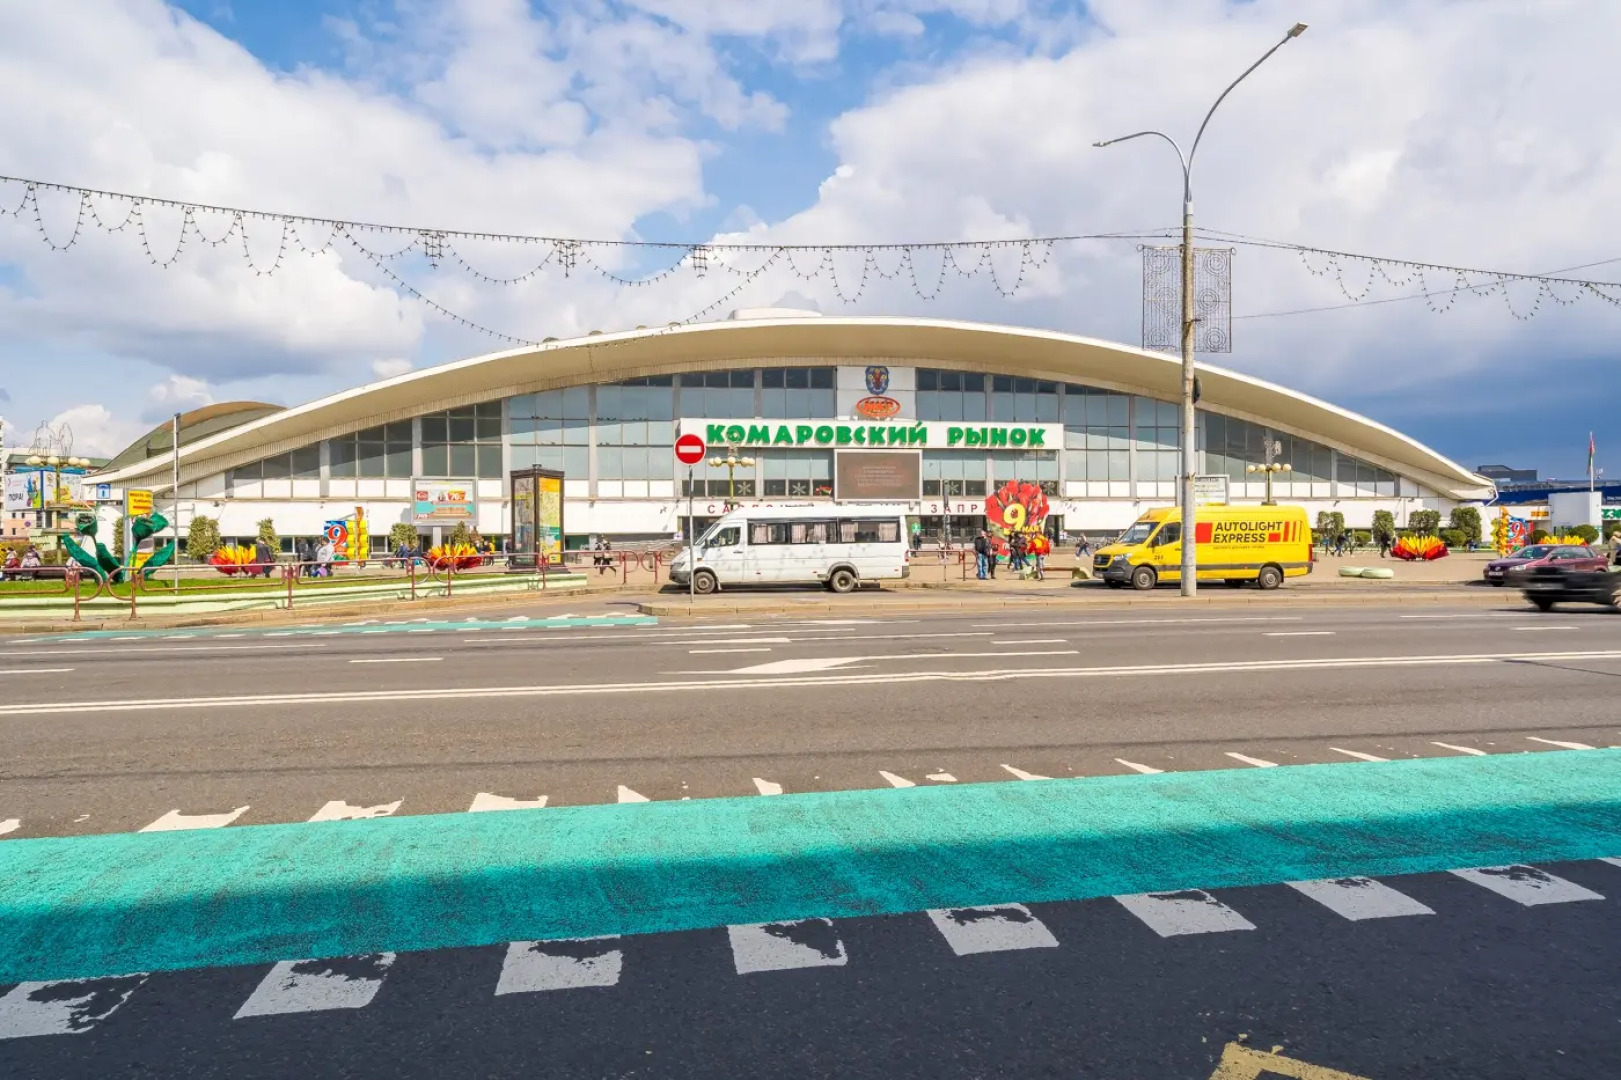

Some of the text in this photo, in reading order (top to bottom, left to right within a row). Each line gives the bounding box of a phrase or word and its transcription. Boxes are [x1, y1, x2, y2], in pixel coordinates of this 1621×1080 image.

[706, 421, 1046, 447] КОМАРОВСКИЙ РЫНОК
[930, 504, 987, 514] ЗАПР
[1003, 503, 1026, 536] 9
[1215, 521, 1283, 532] AUTOLIGHT
[328, 525, 348, 546] 9
[1213, 533, 1266, 544] EXPRESS
[1511, 521, 1525, 539] 9
